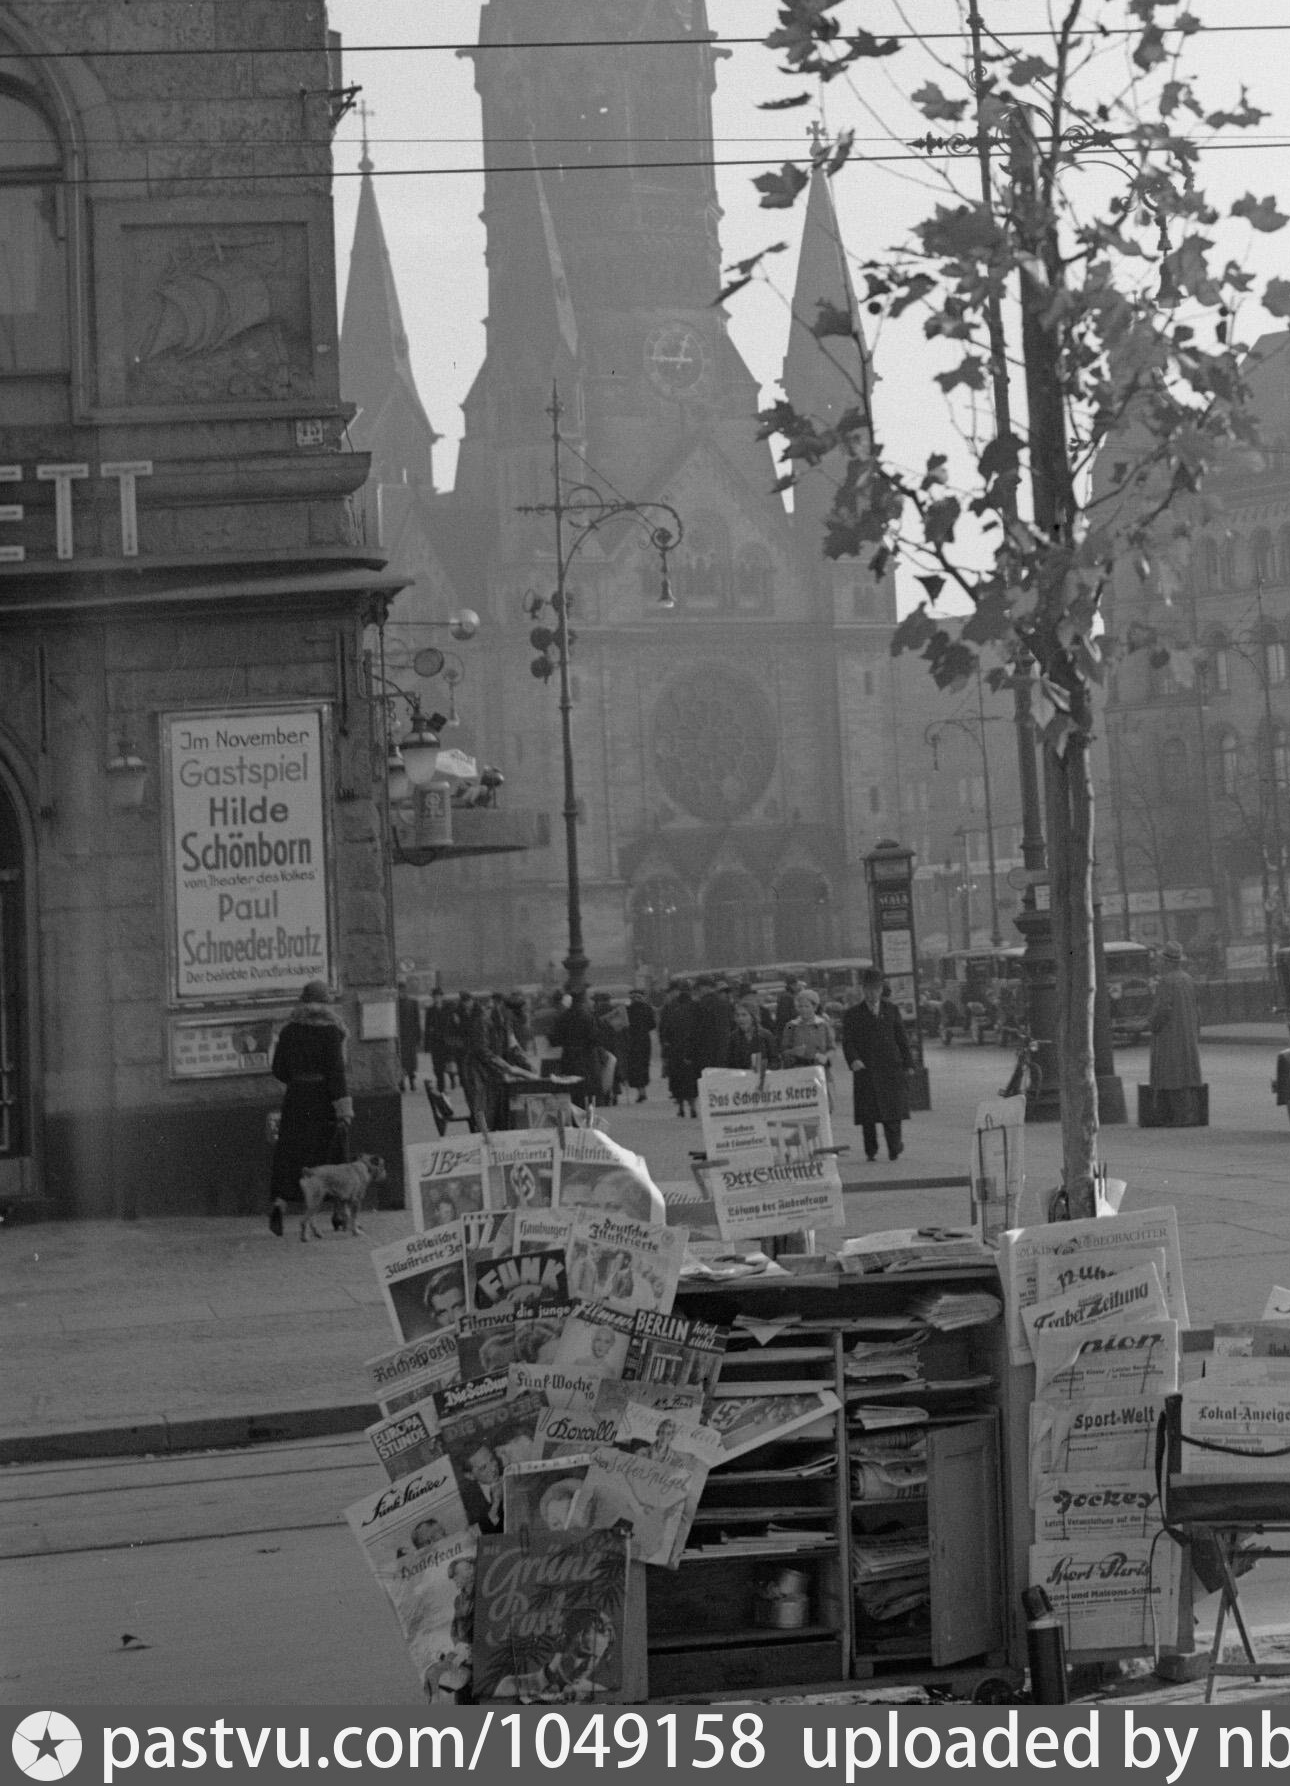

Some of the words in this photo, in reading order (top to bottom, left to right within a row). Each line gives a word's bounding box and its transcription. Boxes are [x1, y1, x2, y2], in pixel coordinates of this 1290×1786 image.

[216, 727, 310, 749] November
[179, 751, 308, 790] Gastspiel
[209, 795, 289, 826] Hilde
[181, 831, 312, 873] Schönborn
[218, 890, 279, 923] Paul
[183, 925, 323, 967] Schroeder-Bratz
[723, 1170, 752, 1188] Der
[753, 1160, 824, 1184] Stürmer
[1094, 1227, 1169, 1246] BEOBACHTER
[478, 1256, 565, 1302] FUNK
[516, 1302, 535, 1319] die
[537, 1304, 571, 1320] junge
[1087, 1281, 1149, 1318] Zeitung
[635, 1310, 691, 1342] BERLIN
[1079, 1332, 1166, 1355] nion
[372, 1414, 424, 1448] EUROPA
[1074, 1405, 1155, 1432] Sport-Welt
[379, 1426, 430, 1461] STUNDE
[1052, 1488, 1160, 1515] Jockey
[482, 1544, 603, 1622] Grüne
[1072, 1589, 1090, 1601] und
